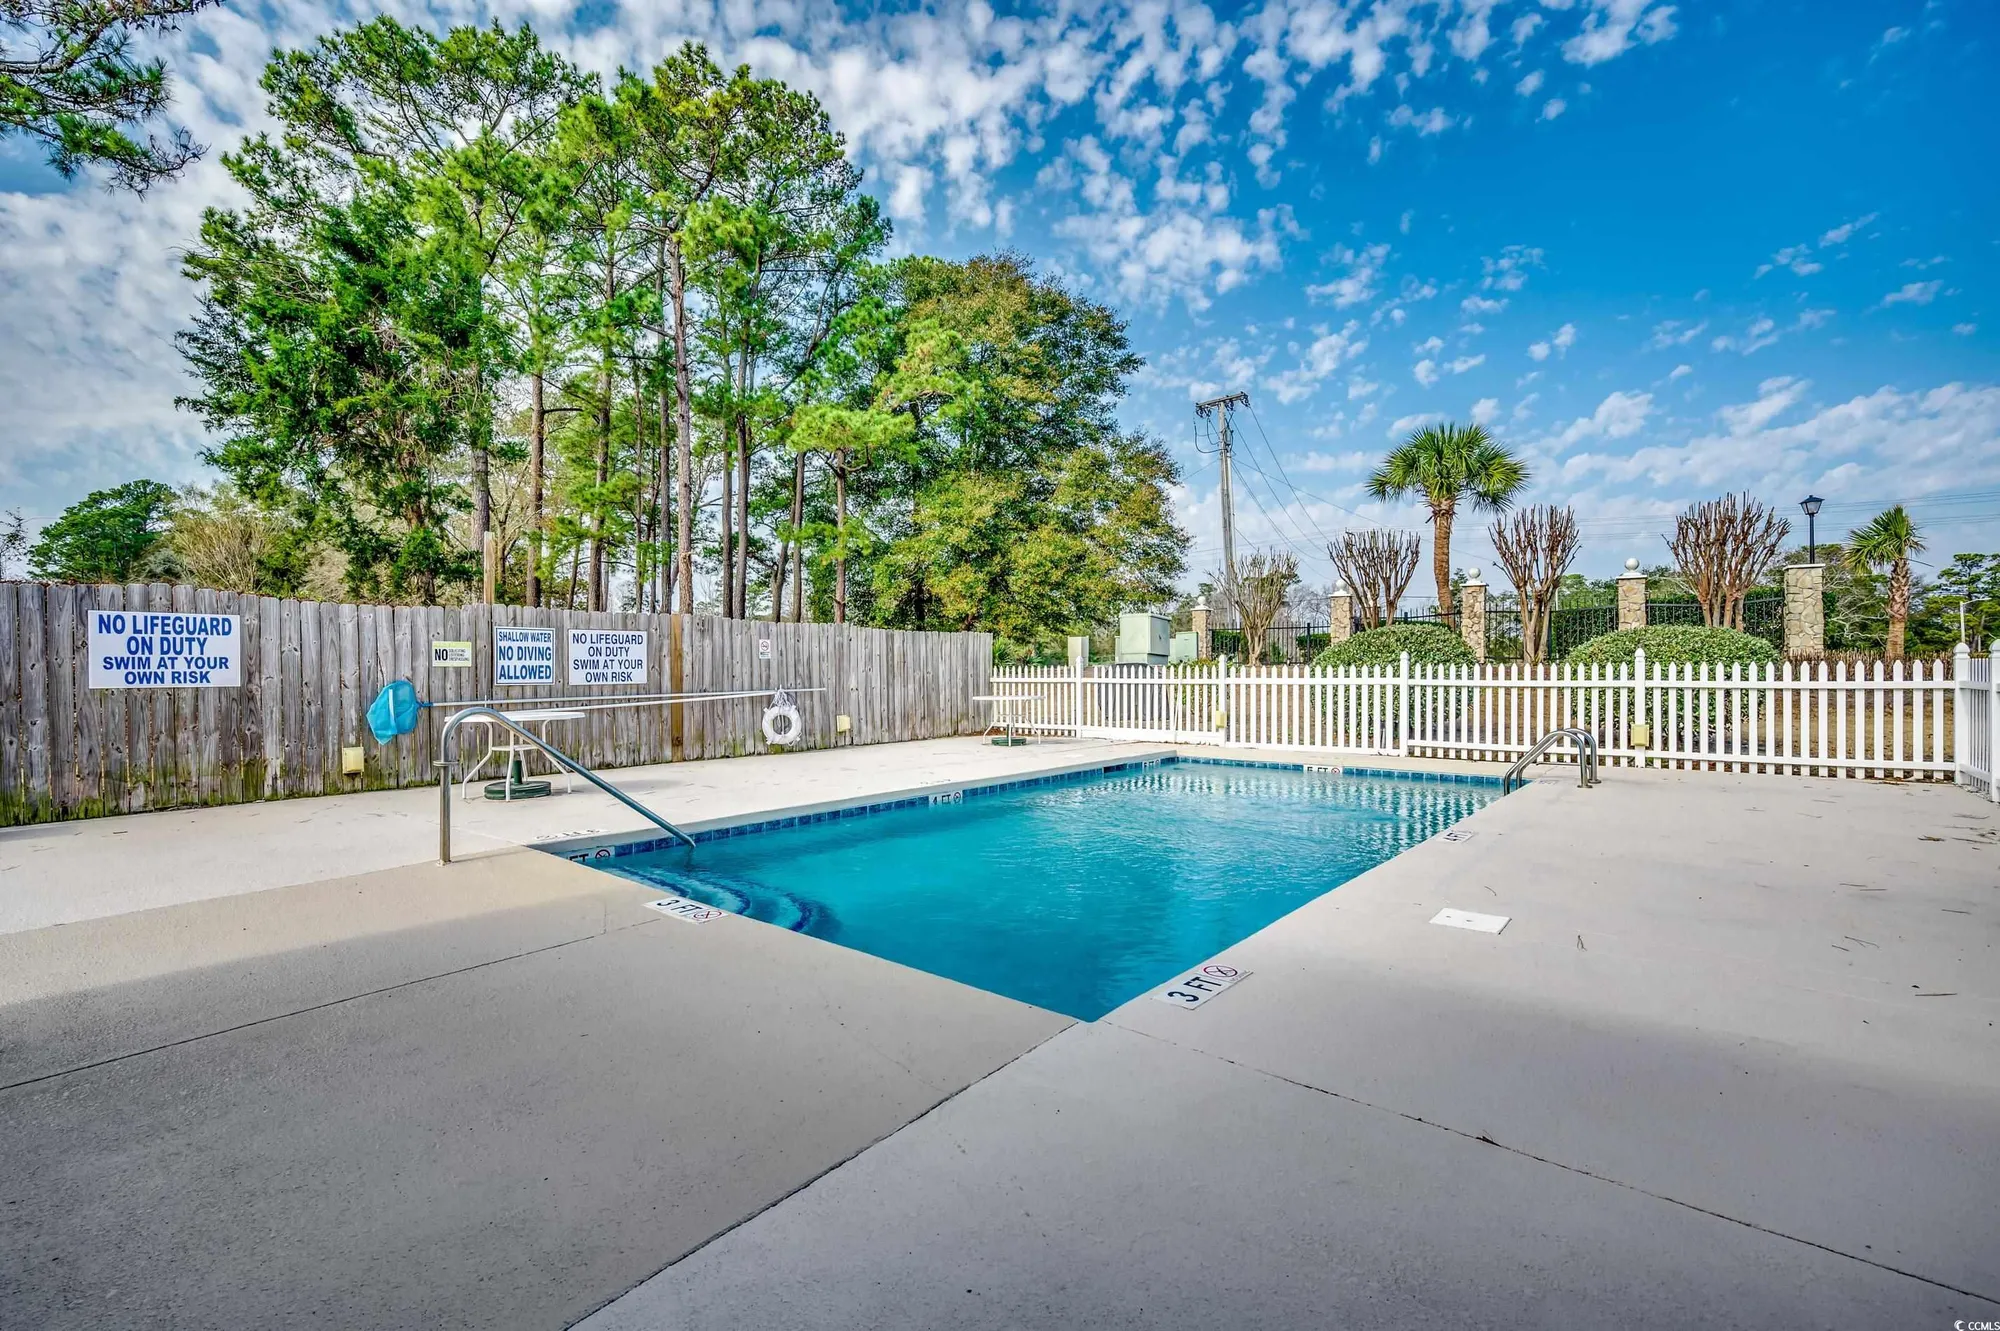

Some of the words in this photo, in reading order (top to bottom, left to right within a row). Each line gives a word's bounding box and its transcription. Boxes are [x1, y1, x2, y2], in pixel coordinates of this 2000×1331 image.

[98, 614, 126, 634] NO
[132, 615, 232, 636] LIFEGUARD
[498, 631, 529, 642] SHALLOW
[530, 632, 552, 643] WATER
[572, 633, 587, 644] NO
[590, 633, 644, 645] LIFEGUARD
[126, 636, 153, 655] ON
[160, 637, 208, 656] DUTY
[588, 646, 602, 657] ON
[605, 646, 630, 657] DUTY
[434, 648, 449, 661] NO
[498, 646, 514, 661] NO
[517, 646, 552, 661] DIVING
[102, 656, 150, 670] SWIM
[157, 657, 178, 669] AT
[183, 656, 229, 669] YOUR
[573, 659, 600, 670] SWIM
[602, 659, 615, 669] AT
[618, 659, 643, 669] YOUR
[124, 671, 165, 685] OWN
[171, 670, 211, 684] RISK
[498, 665, 552, 680] ALLOWED
[585, 671, 608, 683] OWN
[611, 671, 633, 682] RISK
[656, 899, 680, 907] 3
[670, 903, 704, 914] FT
[1167, 991, 1199, 1002] 3
[1183, 976, 1222, 992] FT
